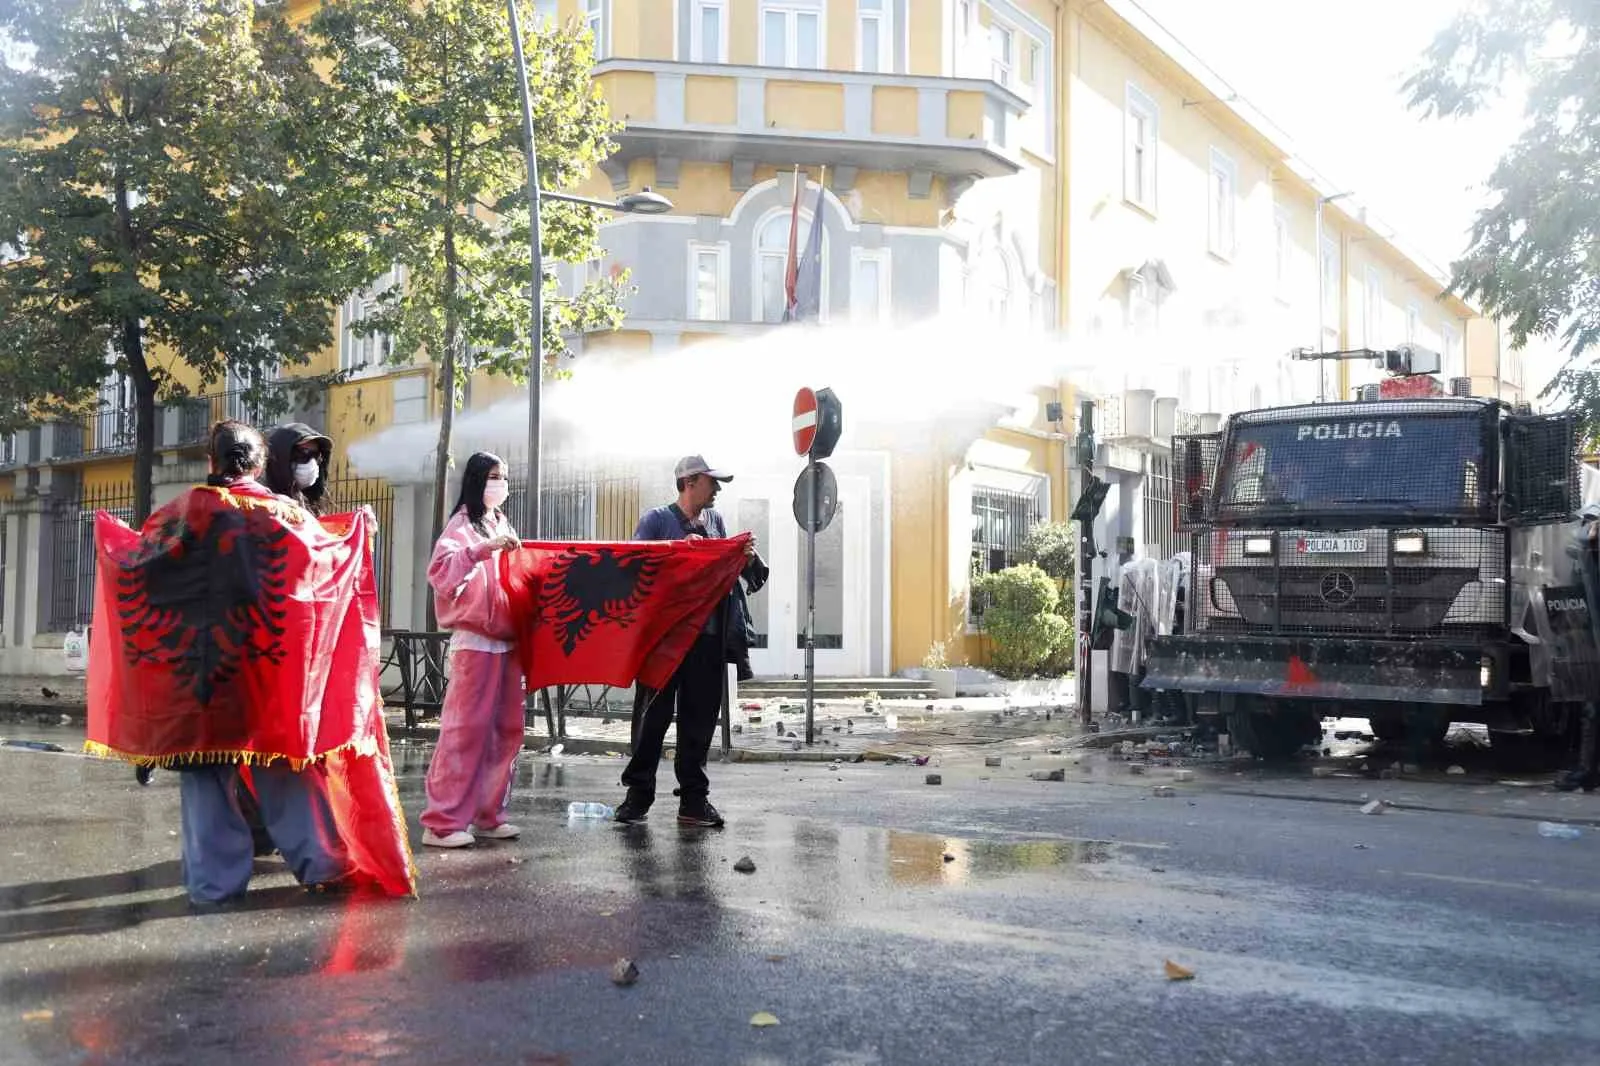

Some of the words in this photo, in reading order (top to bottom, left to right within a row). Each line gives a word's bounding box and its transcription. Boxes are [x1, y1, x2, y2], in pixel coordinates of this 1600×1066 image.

[1297, 421, 1402, 440] POLICIA
[1305, 539, 1338, 552] POLICIA
[1547, 598, 1587, 611] POLICIA
